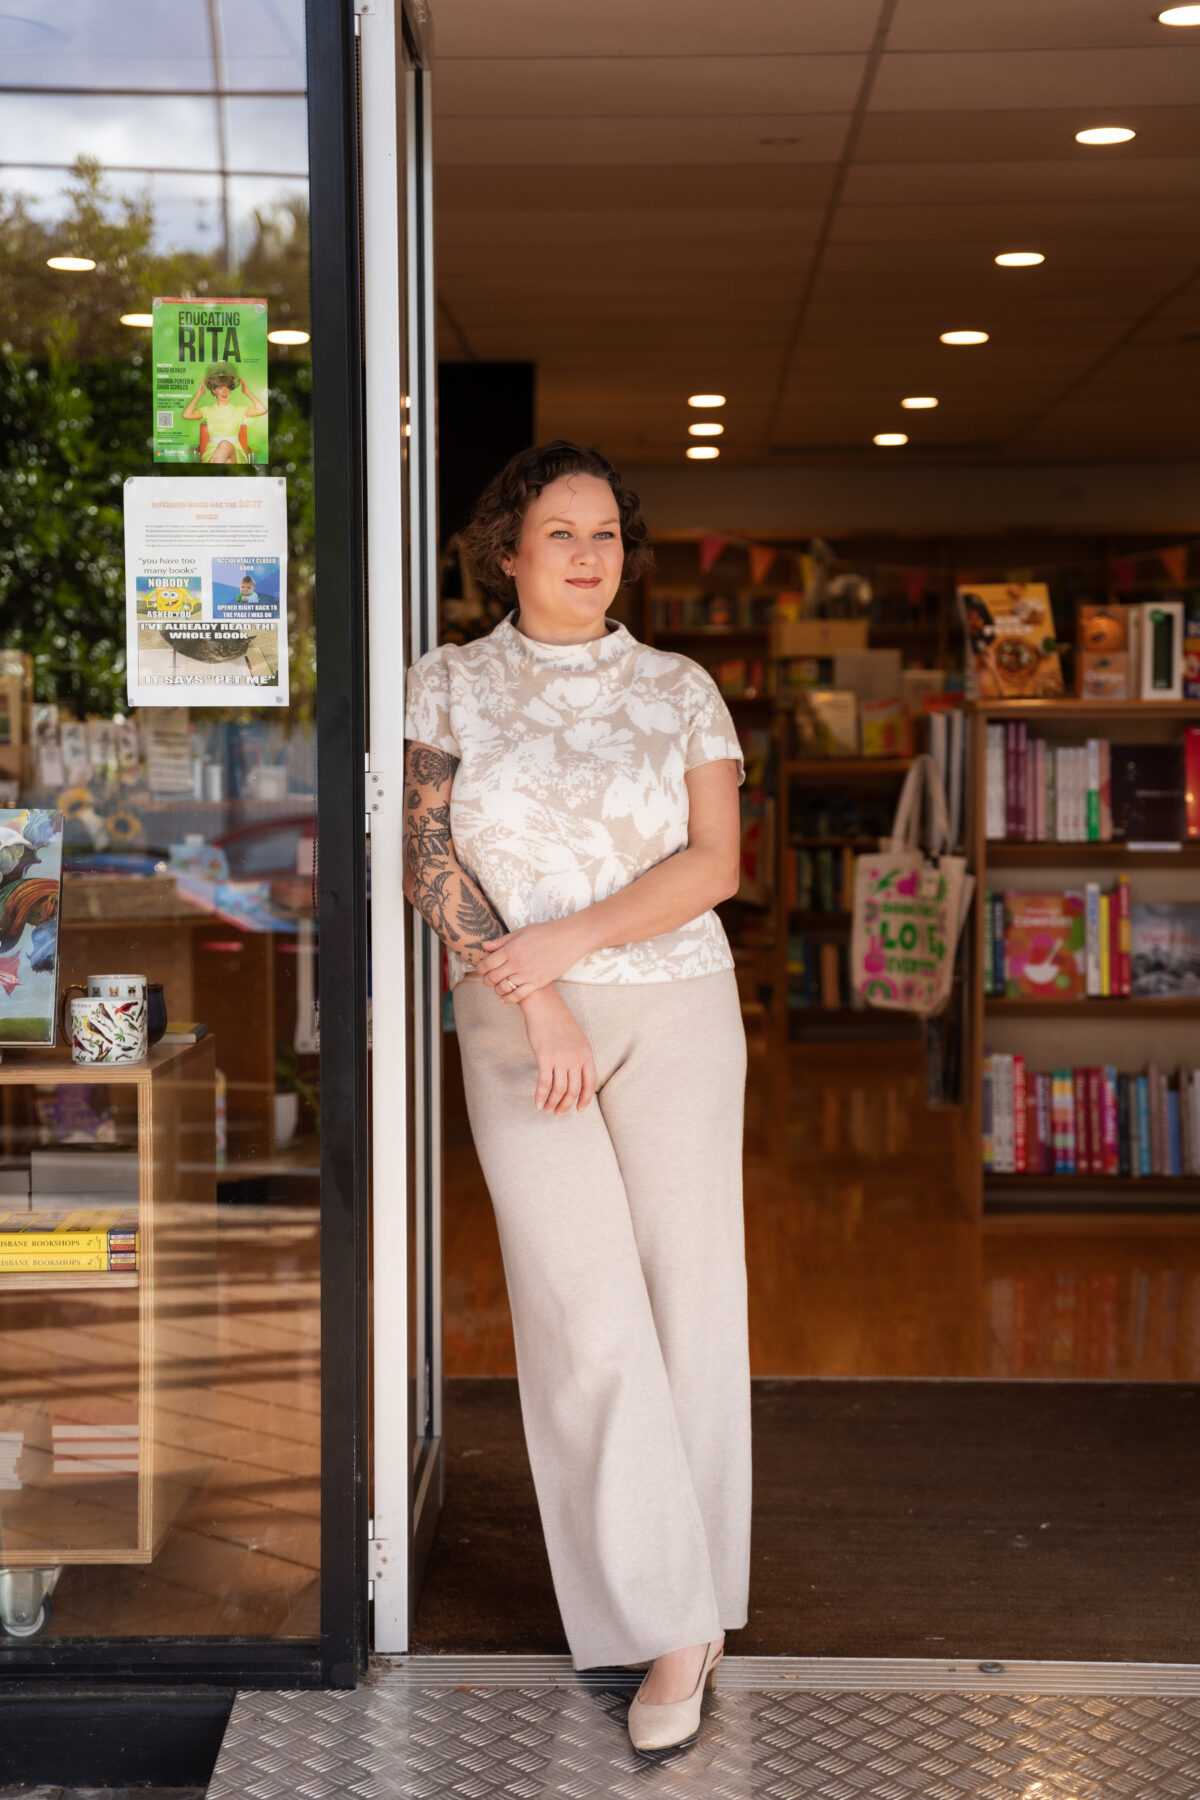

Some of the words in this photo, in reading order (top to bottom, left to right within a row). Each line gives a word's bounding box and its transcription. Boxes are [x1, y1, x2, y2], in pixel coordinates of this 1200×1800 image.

[178, 312, 240, 326] EDUCATING
[178, 327, 241, 362] RITA
[138, 558, 158, 566] "you
[148, 578, 190, 587] NOBODY
[147, 610, 172, 618] ASKED
[174, 610, 191, 618] YOU
[144, 675, 160, 684] IT
[163, 675, 204, 684] SAYS
[207, 675, 240, 684] "PET
[245, 675, 276, 684] ME"
[880, 922, 938, 952] LOE
